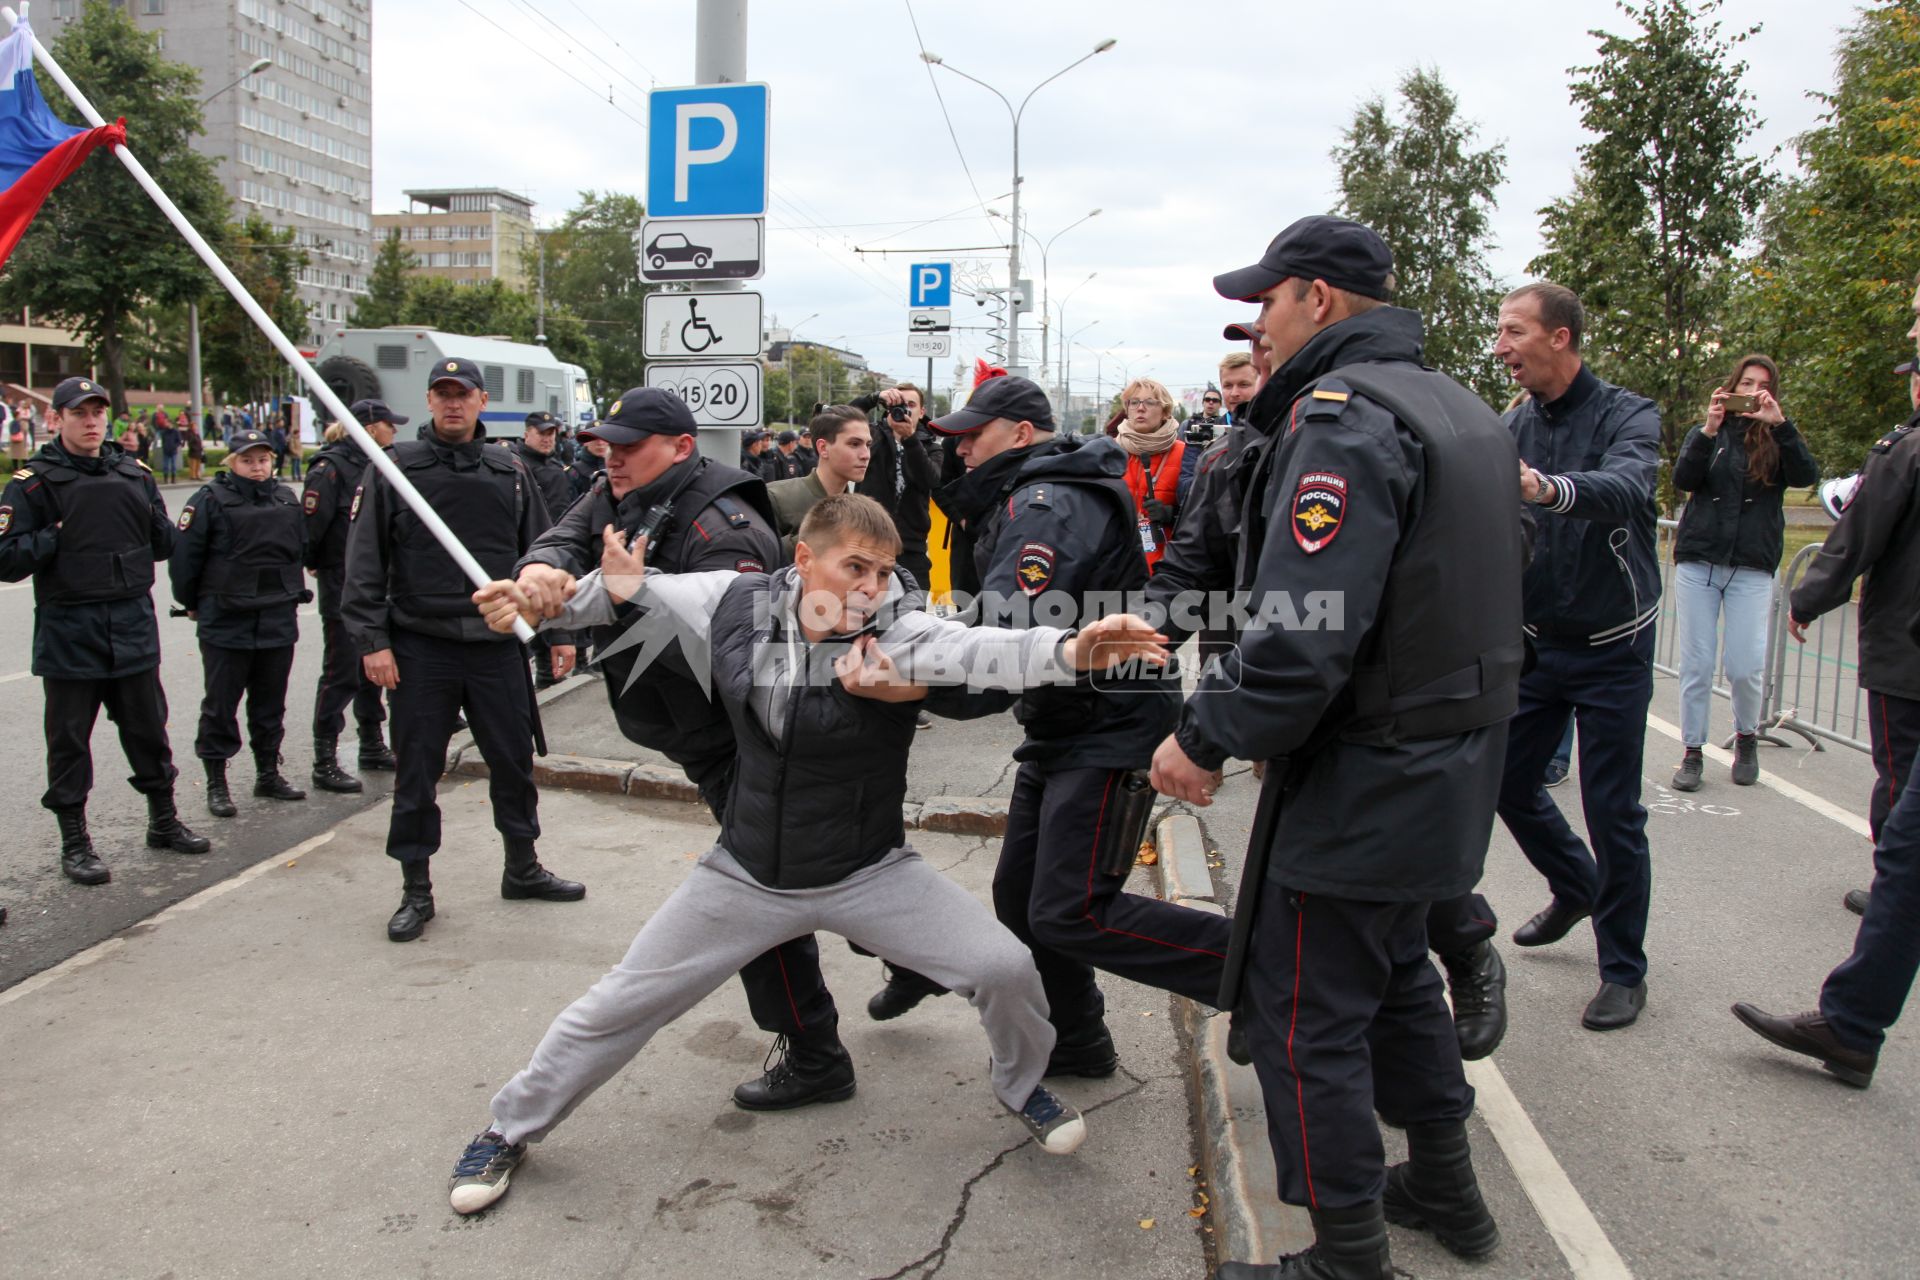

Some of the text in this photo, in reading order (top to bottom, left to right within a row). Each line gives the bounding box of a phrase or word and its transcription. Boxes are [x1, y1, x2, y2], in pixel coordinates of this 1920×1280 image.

[674, 103, 738, 203] P
[919, 268, 942, 303] P
[932, 342, 943, 350] 20
[681, 383, 738, 405] 15 20
[1303, 475, 1344, 489] ПОЛИЦИЯ
[1300, 492, 1340, 508] РОССИЯ
